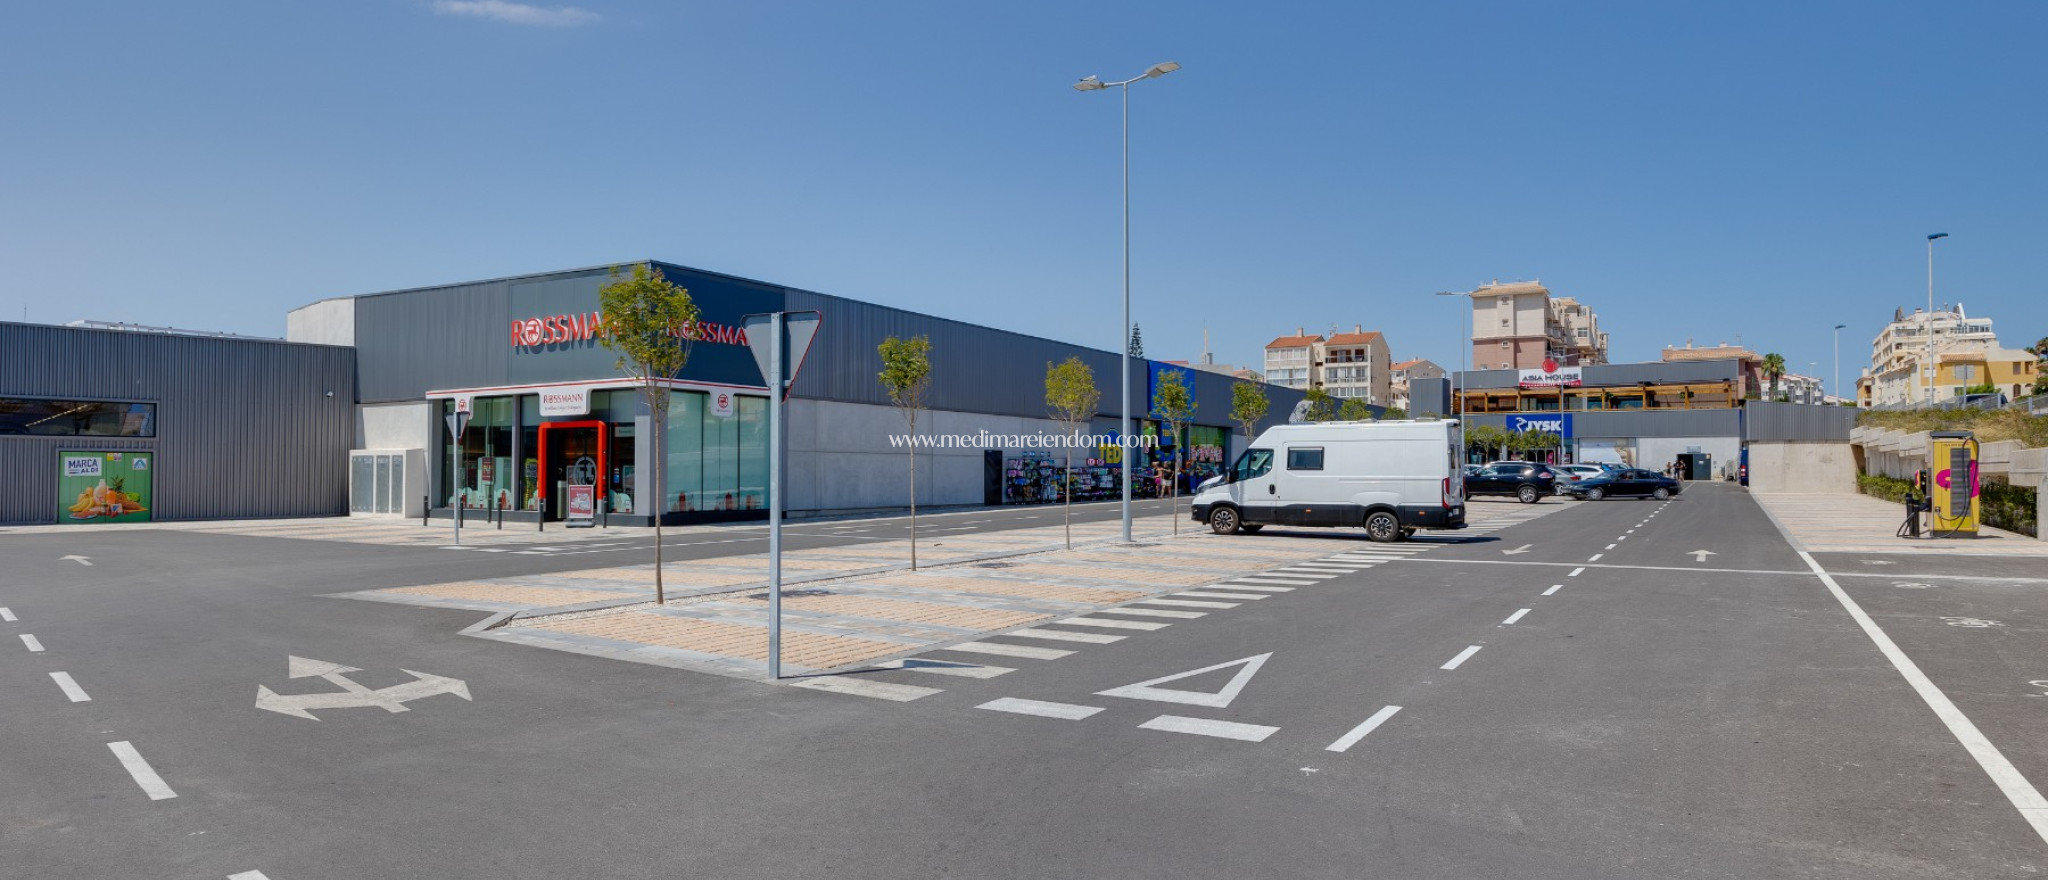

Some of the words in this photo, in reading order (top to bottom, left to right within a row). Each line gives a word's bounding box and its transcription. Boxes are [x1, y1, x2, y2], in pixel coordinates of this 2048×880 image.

[511, 312, 620, 347] ROSSMA
[667, 318, 749, 346] ROSSMA
[1545, 373, 1578, 381] HOUSE
[543, 393, 584, 404] ROSSMANN
[1525, 420, 1562, 431] JYSK
[1098, 443, 1123, 464] TED
[68, 459, 98, 468] MARCA
